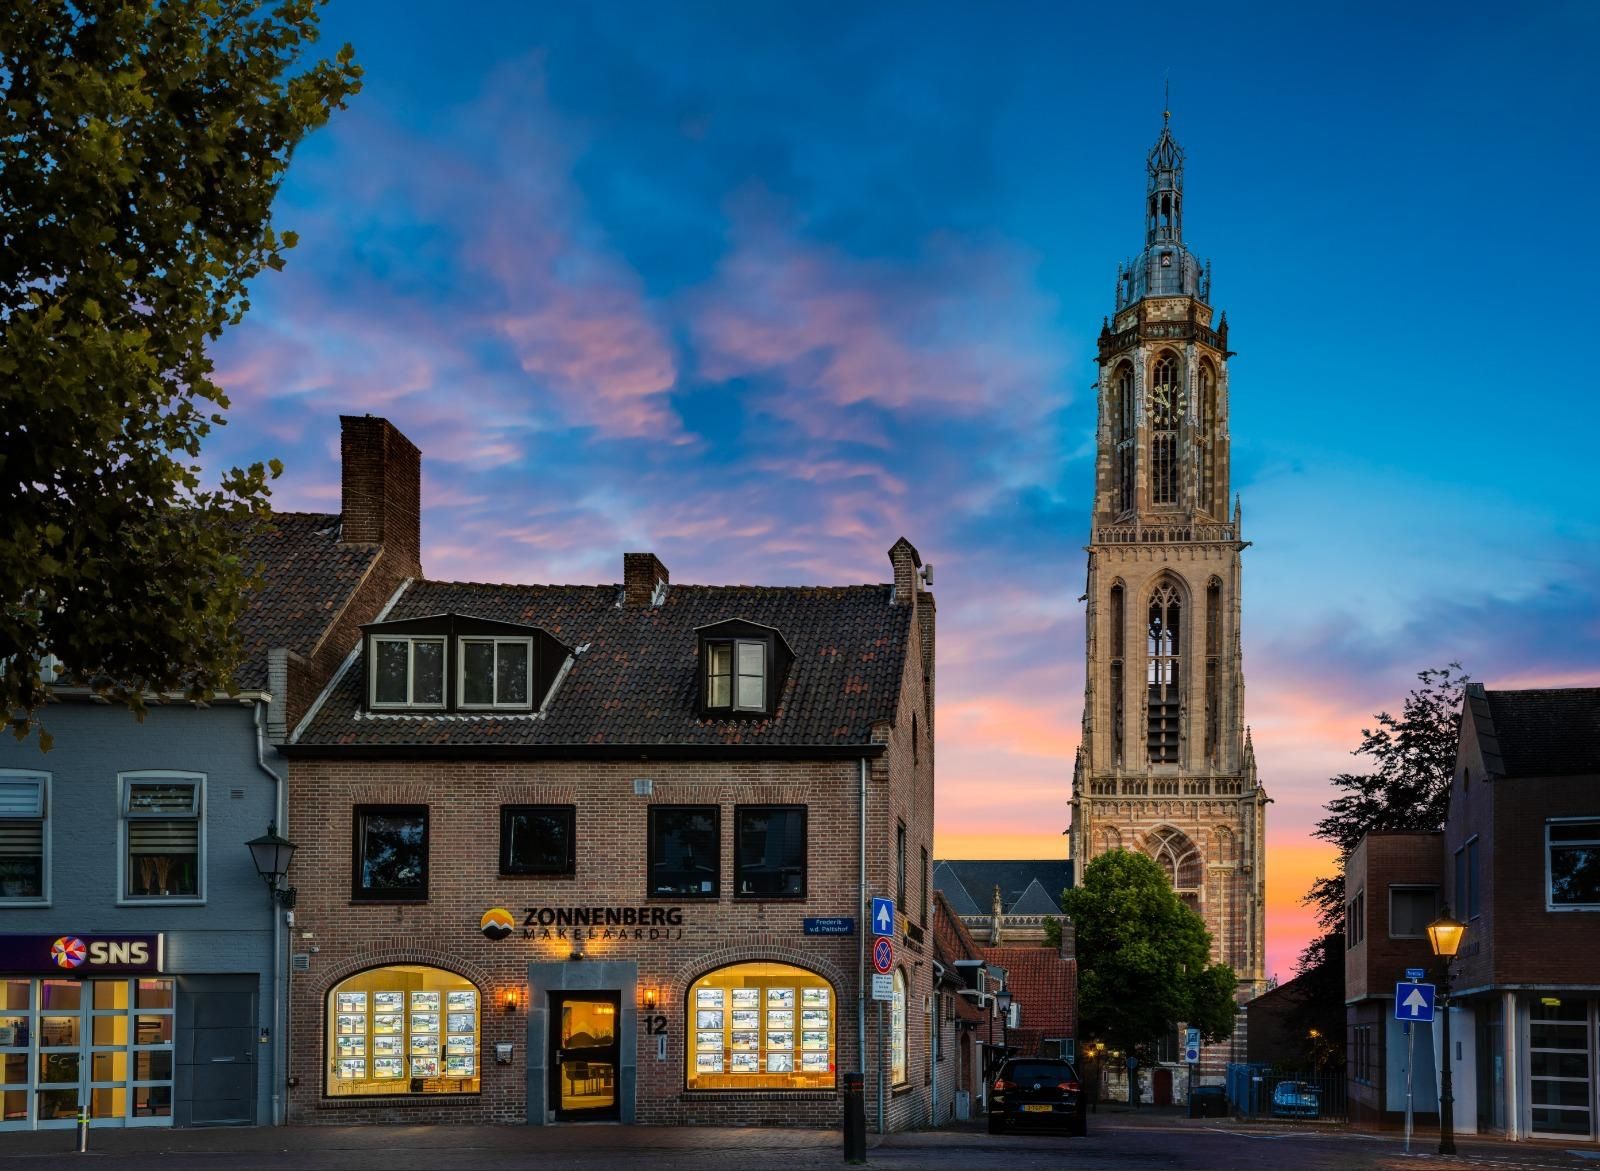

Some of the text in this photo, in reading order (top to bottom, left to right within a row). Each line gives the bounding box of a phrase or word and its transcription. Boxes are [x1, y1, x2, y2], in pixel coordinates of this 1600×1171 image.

[524, 907, 682, 925] ZONNENBERG
[523, 928, 682, 940] MAKELAARDIJ
[89, 941, 149, 964] SNS
[644, 1015, 668, 1035] 12
